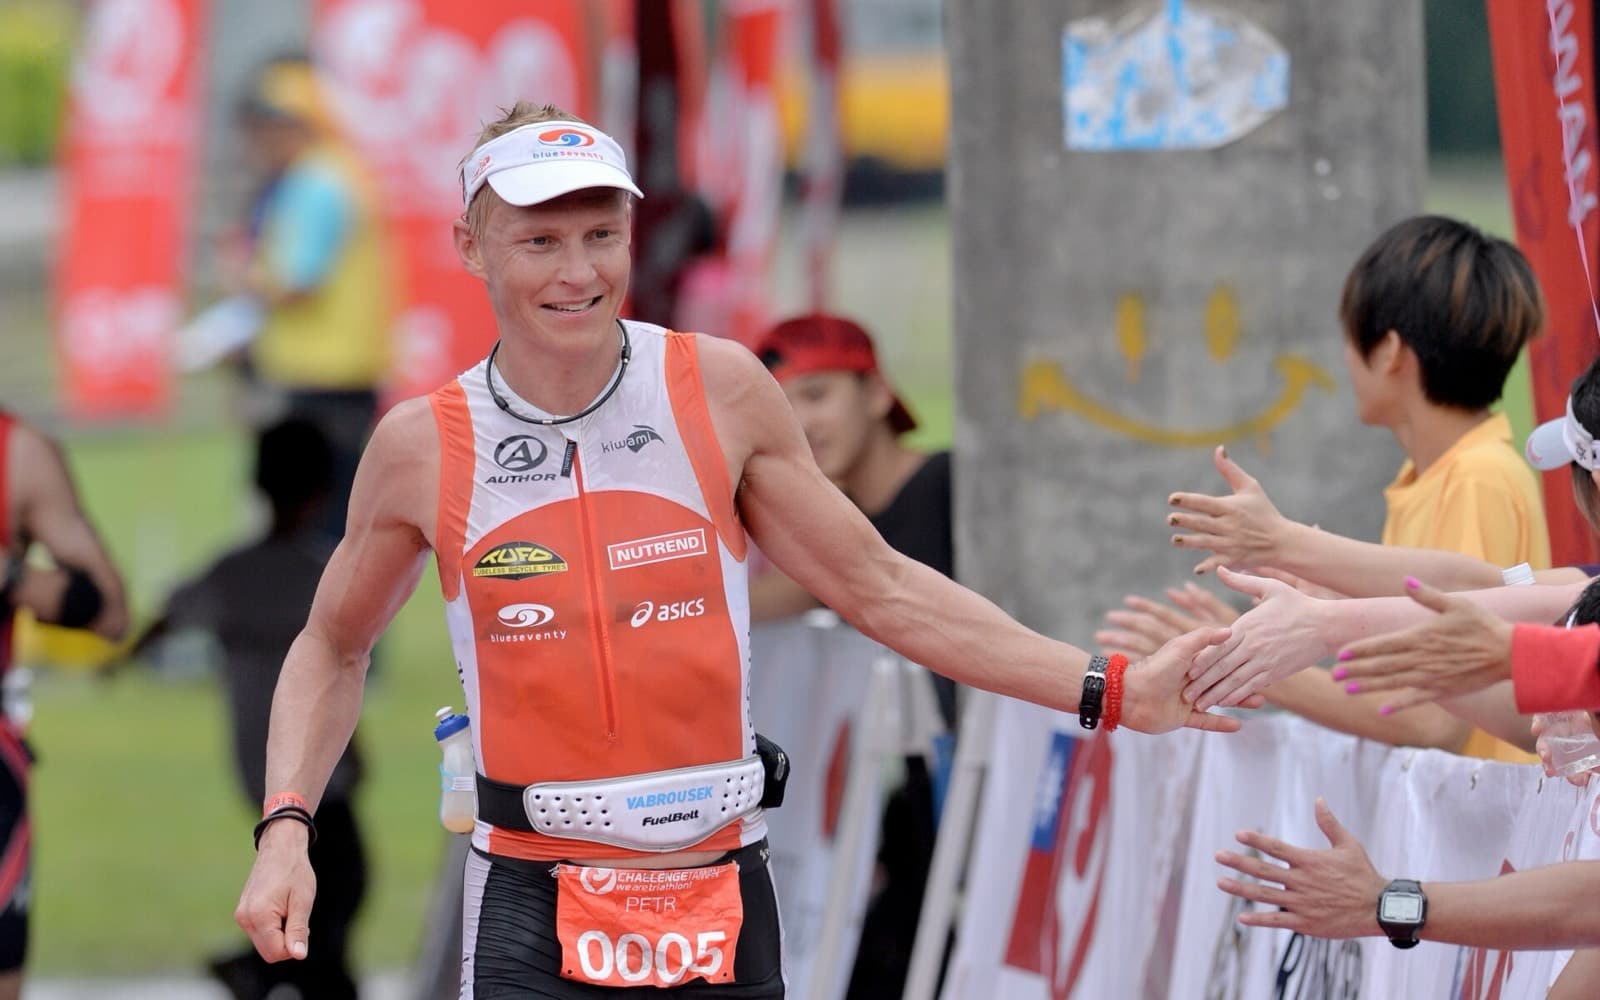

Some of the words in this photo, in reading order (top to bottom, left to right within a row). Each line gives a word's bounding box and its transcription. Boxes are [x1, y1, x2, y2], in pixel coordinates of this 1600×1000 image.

[532, 151, 604, 160] blueseventy
[601, 431, 651, 454] kiwami
[485, 473, 557, 484] AUTHOR
[480, 547, 553, 564] TUFO
[616, 536, 699, 562] NUTREND
[490, 629, 567, 643] blueseventy
[627, 785, 714, 810] VABROUSEK
[642, 810, 699, 827] FuelBelt
[616, 884, 631, 892] we
[625, 896, 676, 913] PETR
[576, 930, 727, 984] 0005
